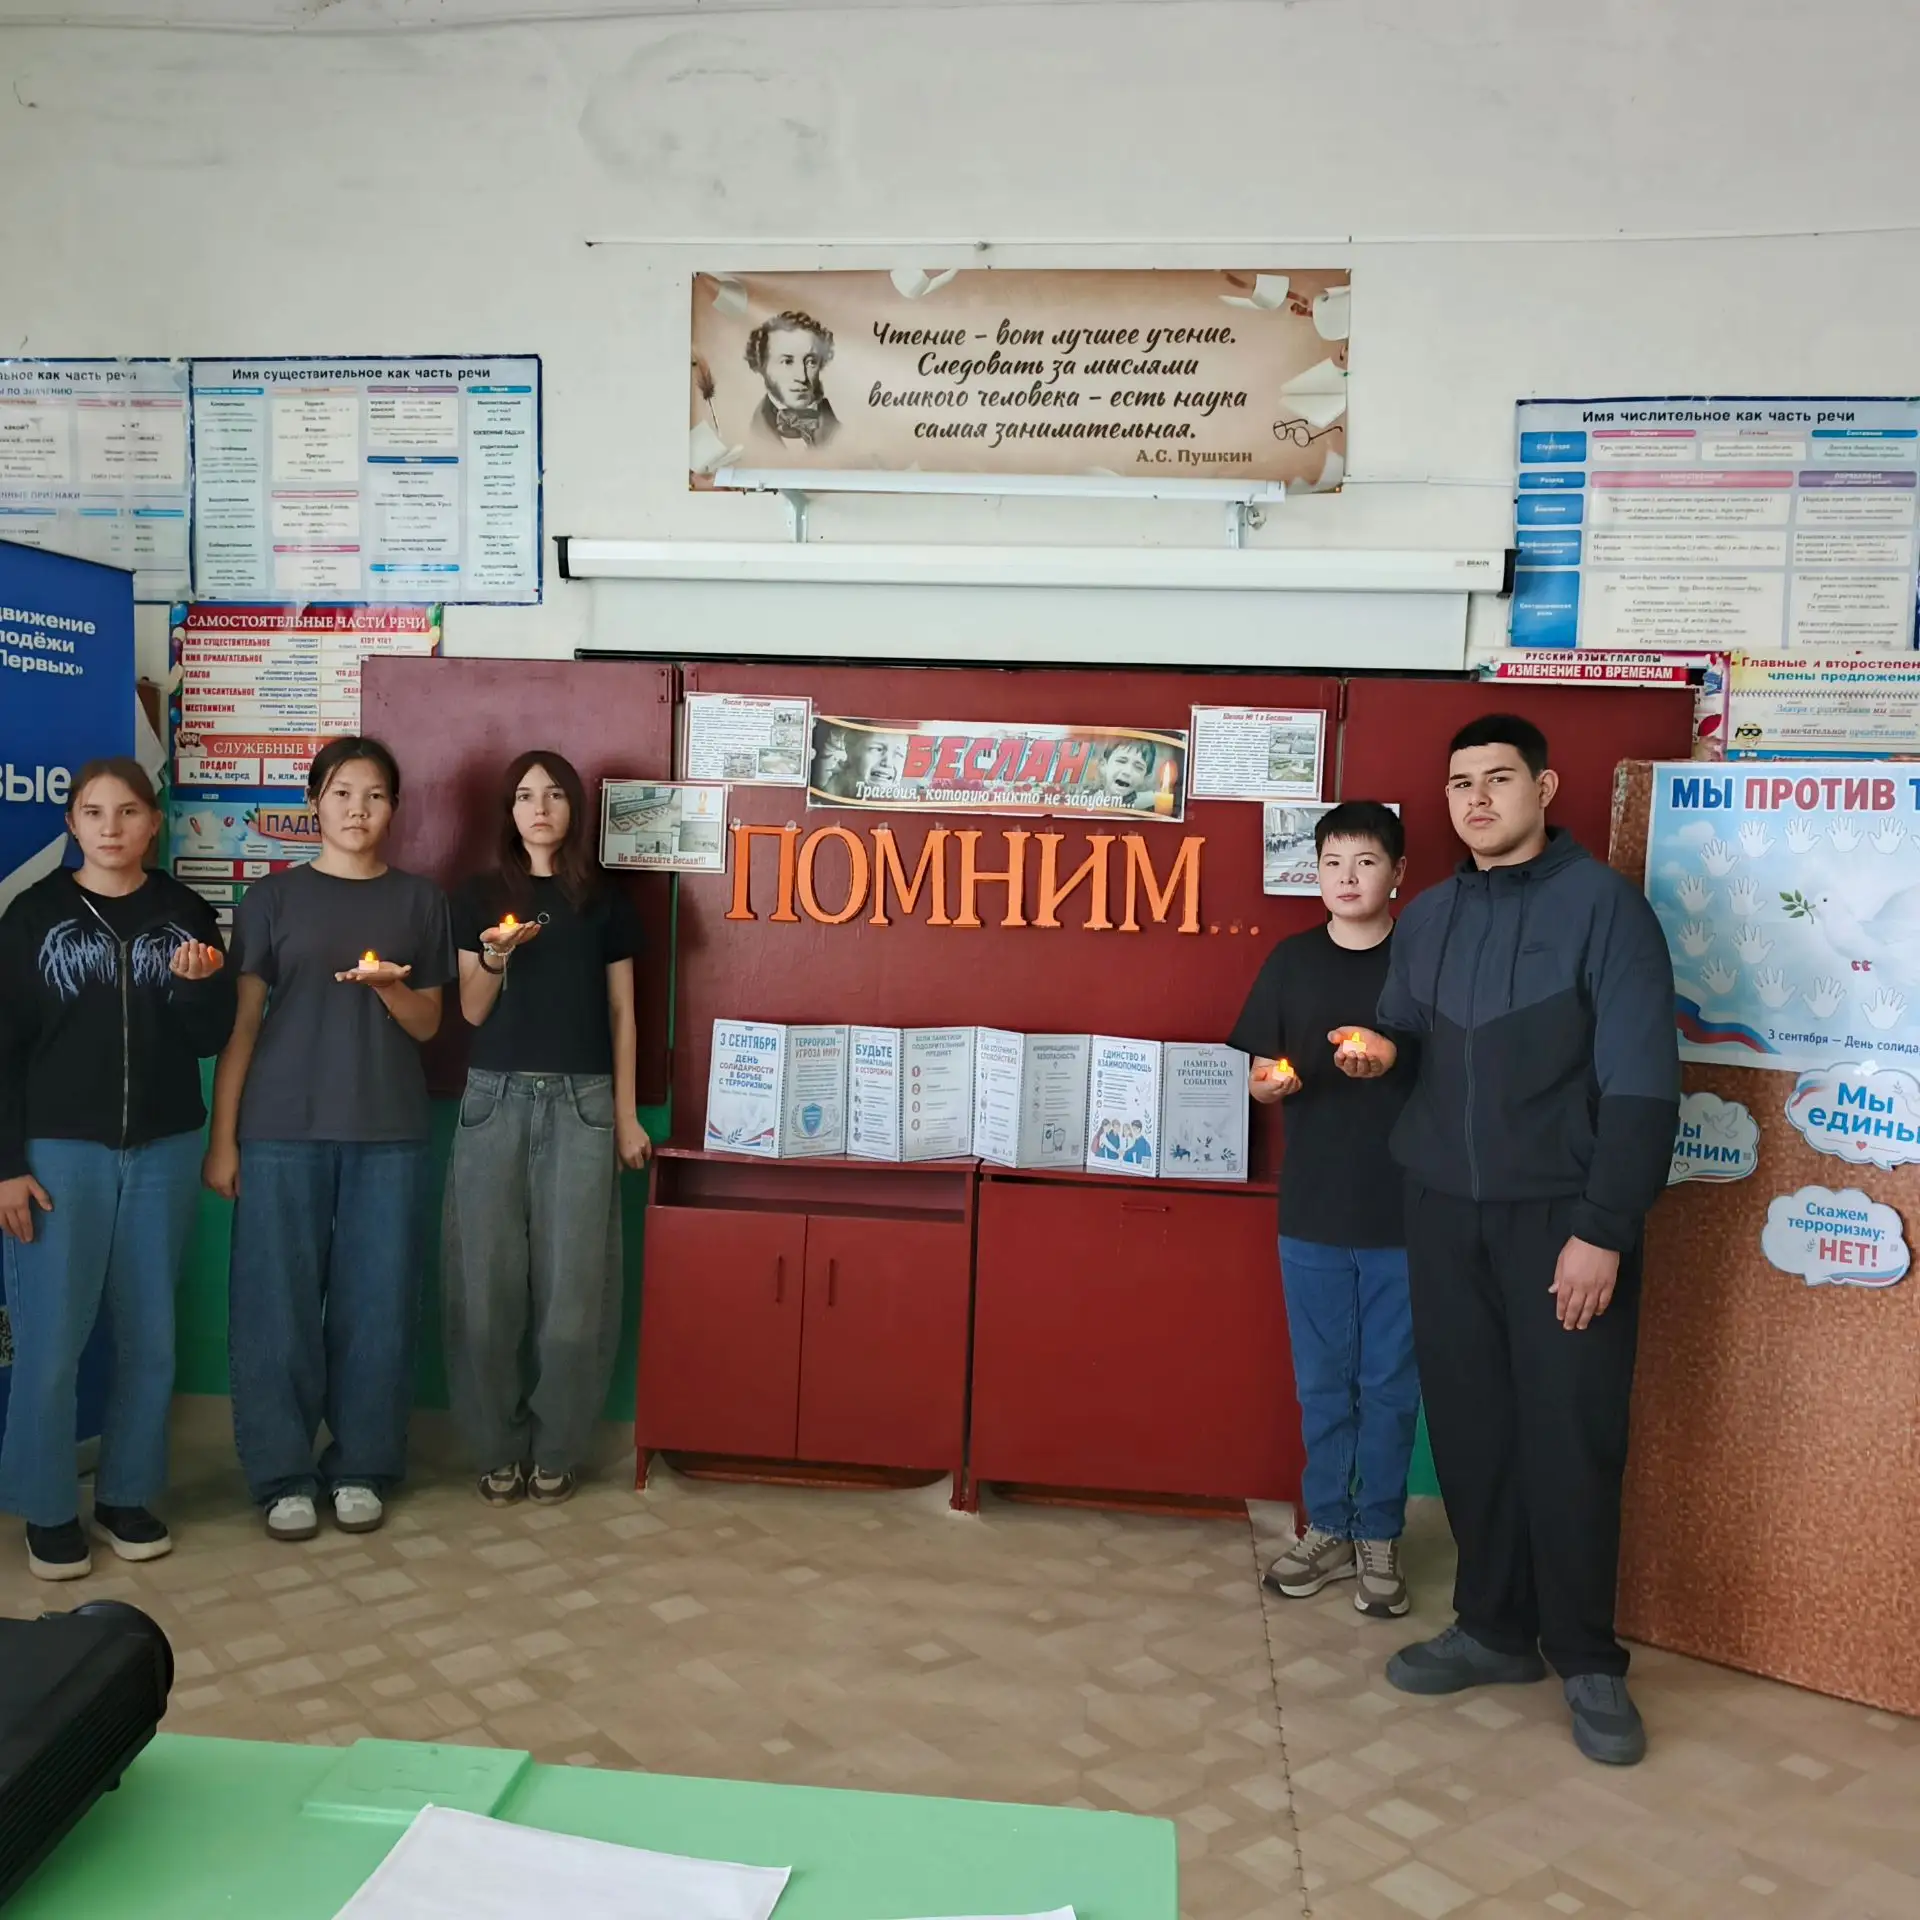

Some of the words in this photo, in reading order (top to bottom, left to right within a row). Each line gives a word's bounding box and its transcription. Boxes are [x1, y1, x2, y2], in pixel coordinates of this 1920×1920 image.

[872, 321, 966, 346] Чтение
[996, 318, 1044, 346] вот
[1051, 329, 1140, 355] лучшее
[1146, 329, 1237, 355] учение.
[232, 369, 259, 380] Имя
[263, 368, 382, 382] существительное
[387, 369, 410, 378] как
[415, 368, 453, 379] часть
[458, 369, 491, 381] речи
[917, 353, 1046, 379] Следовать
[1051, 360, 1078, 384] за
[1083, 360, 1199, 376] мыслями
[37, 371, 60, 380] как
[65, 371, 101, 380] часть
[868, 381, 969, 409] великого
[977, 381, 1081, 408] человека
[1110, 391, 1166, 408] есть
[1174, 391, 1248, 417] наука
[1582, 410, 1615, 423] Имя
[1619, 409, 1731, 423] числительное
[1735, 411, 1764, 422] как
[1768, 410, 1812, 423] часть
[1817, 411, 1855, 424] речи
[914, 422, 987, 440] самая
[991, 421, 1196, 448] занимательная.
[1136, 449, 1173, 464] А.С.
[1178, 449, 1253, 466] Пушкин
[0, 606, 96, 635] вижение
[186, 614, 334, 629] САМОСТОЯТЕЛЬНЫЕ
[337, 616, 387, 629] ЧАСТИ
[389, 617, 426, 629] РЕЧИ
[203, 638, 271, 647] СУЩЕСТВИТЕЛЬНОЕ
[203, 654, 263, 663] ПРИЛАГАТЕЛЬНОЕ
[1525, 652, 1574, 661] РУССКИЙ
[1610, 654, 1662, 663] ГЛАГОЛЫ
[1742, 657, 1807, 669] Главные
[1507, 663, 1581, 678] ИЗМЕНЕНИЕ
[1584, 665, 1601, 678] ПО
[1605, 667, 1673, 680] ВРЕМЕНАМ
[1767, 671, 1816, 682] члены
[203, 687, 255, 696] ЧИСЛИТЕЛЬНОЕ
[185, 704, 235, 713] МЕСТОИМЕНИЕ
[185, 720, 216, 729] НАРЕЧИЕ
[213, 742, 304, 755] СЛУЖЕБНЫЕ
[199, 760, 237, 771] ПРЕДЛОГ
[900, 734, 1096, 785] БЕСЛАН
[0, 762, 72, 804] ые
[224, 772, 250, 781] перед
[855, 780, 921, 802] Трагедия,
[924, 785, 991, 806] которую
[993, 788, 1040, 805] никто
[1044, 792, 1061, 805] не
[1064, 790, 1136, 812] забудет...
[1671, 777, 1733, 809] МЫ
[1744, 777, 1896, 811] ПРОТИВ
[618, 852, 628, 862] Не
[724, 824, 1259, 934] ПОМНИМ...
[720, 1032, 726, 1047] 3
[728, 1033, 777, 1052] СЕНТЯБРЯ
[795, 1036, 837, 1048] ТЕРРОРИЗМ
[1768, 1028, 1775, 1039] 3
[1778, 1029, 1829, 1046] сентября
[1844, 1035, 1874, 1049] День
[795, 1048, 821, 1059] УГРОЗА
[822, 1047, 840, 1058] МИРУ
[855, 1044, 893, 1058] БУДЬТЕ
[1103, 1049, 1139, 1061] ЕДИНСТВО
[735, 1054, 759, 1064] ДЕНЬ
[1183, 1060, 1218, 1068] ПАМЯТЬ
[719, 1062, 774, 1075] СОЛИДАРНОСТИ
[1176, 1068, 1234, 1078] ТРАГИЧЕСКИХ
[736, 1072, 762, 1082] БОРЬБЕ
[1183, 1078, 1228, 1086] СОБЫТИЯХ
[725, 1078, 773, 1091] ТЕРРОРИЗМОМ
[1837, 1082, 1895, 1115] Мы
[1805, 1201, 1869, 1223] Скажем
[1787, 1216, 1886, 1241] терроризму:
[1819, 1237, 1879, 1268] НЕТ!
